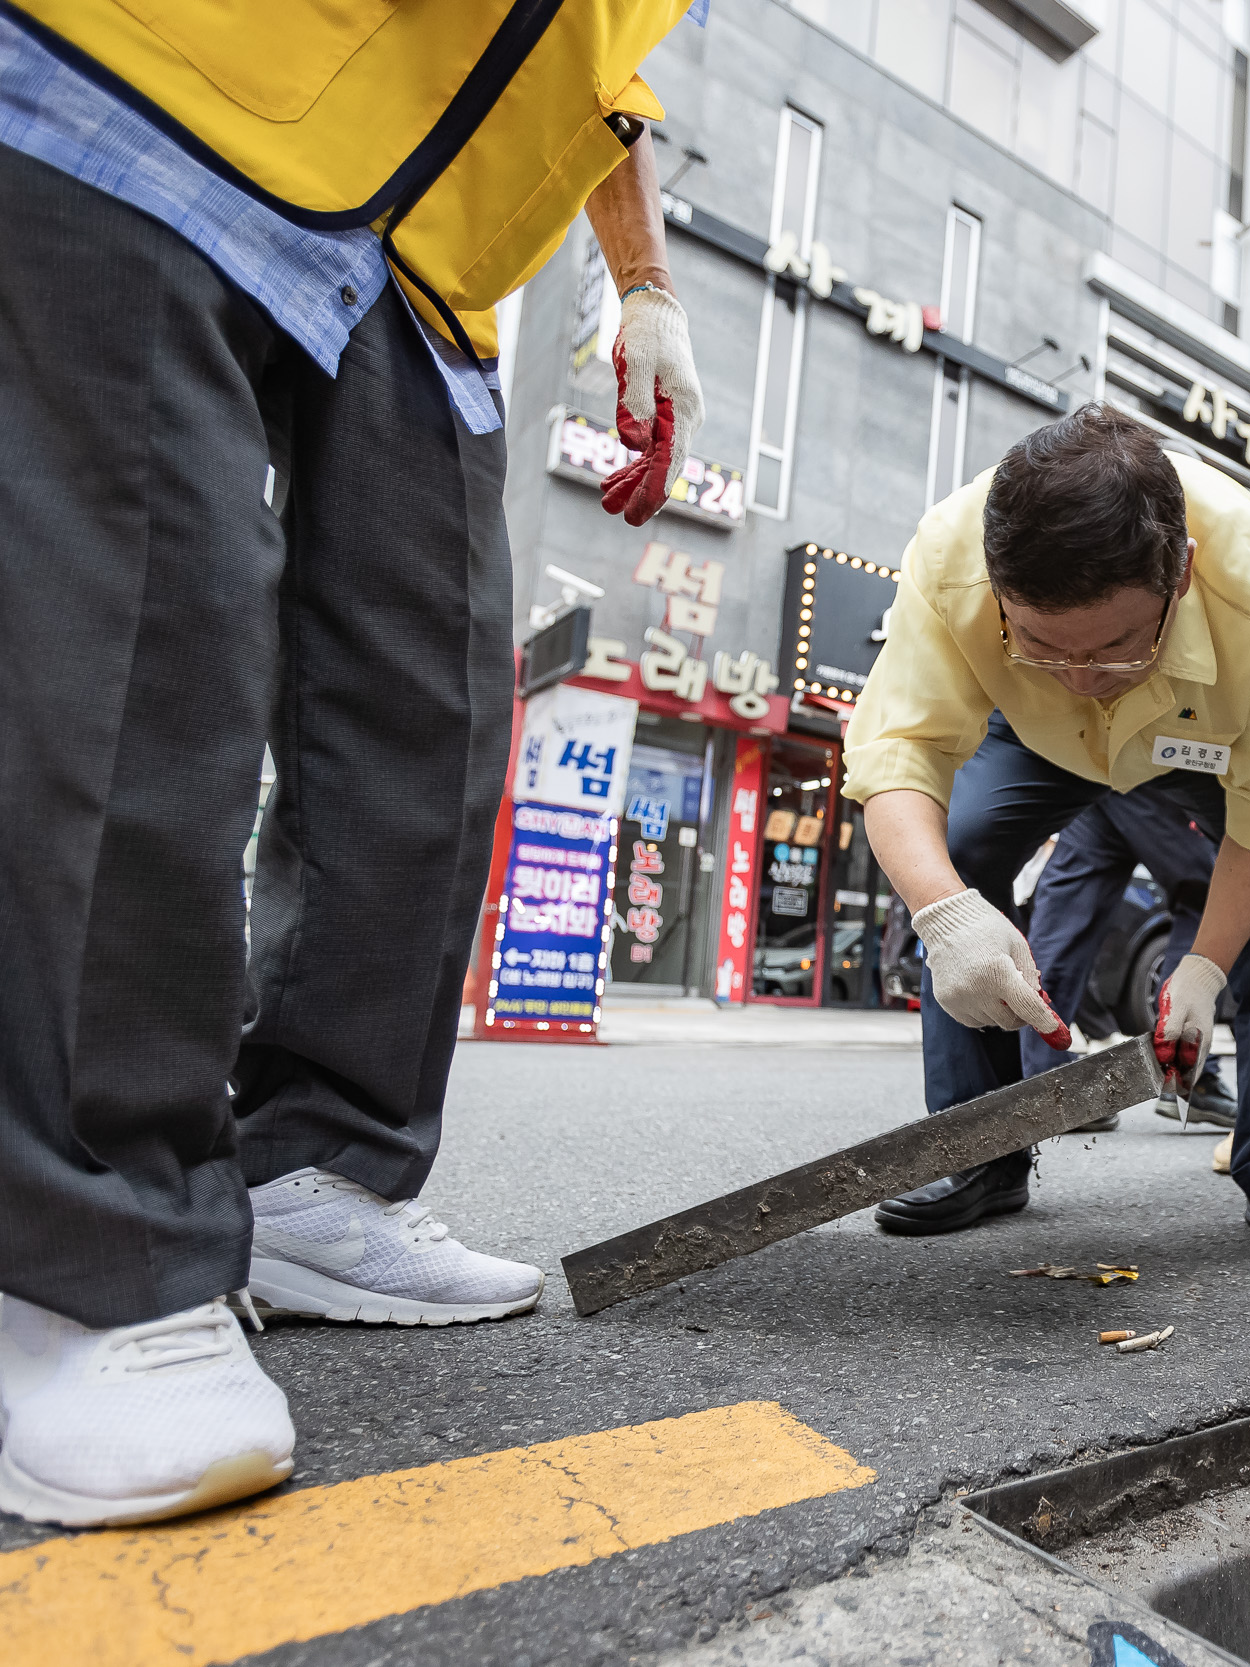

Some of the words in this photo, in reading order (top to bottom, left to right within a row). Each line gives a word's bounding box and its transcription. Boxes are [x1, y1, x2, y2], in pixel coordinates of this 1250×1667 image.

[700, 469, 744, 519] 24
[633, 541, 725, 637] 썸
[558, 740, 617, 798] 썸
